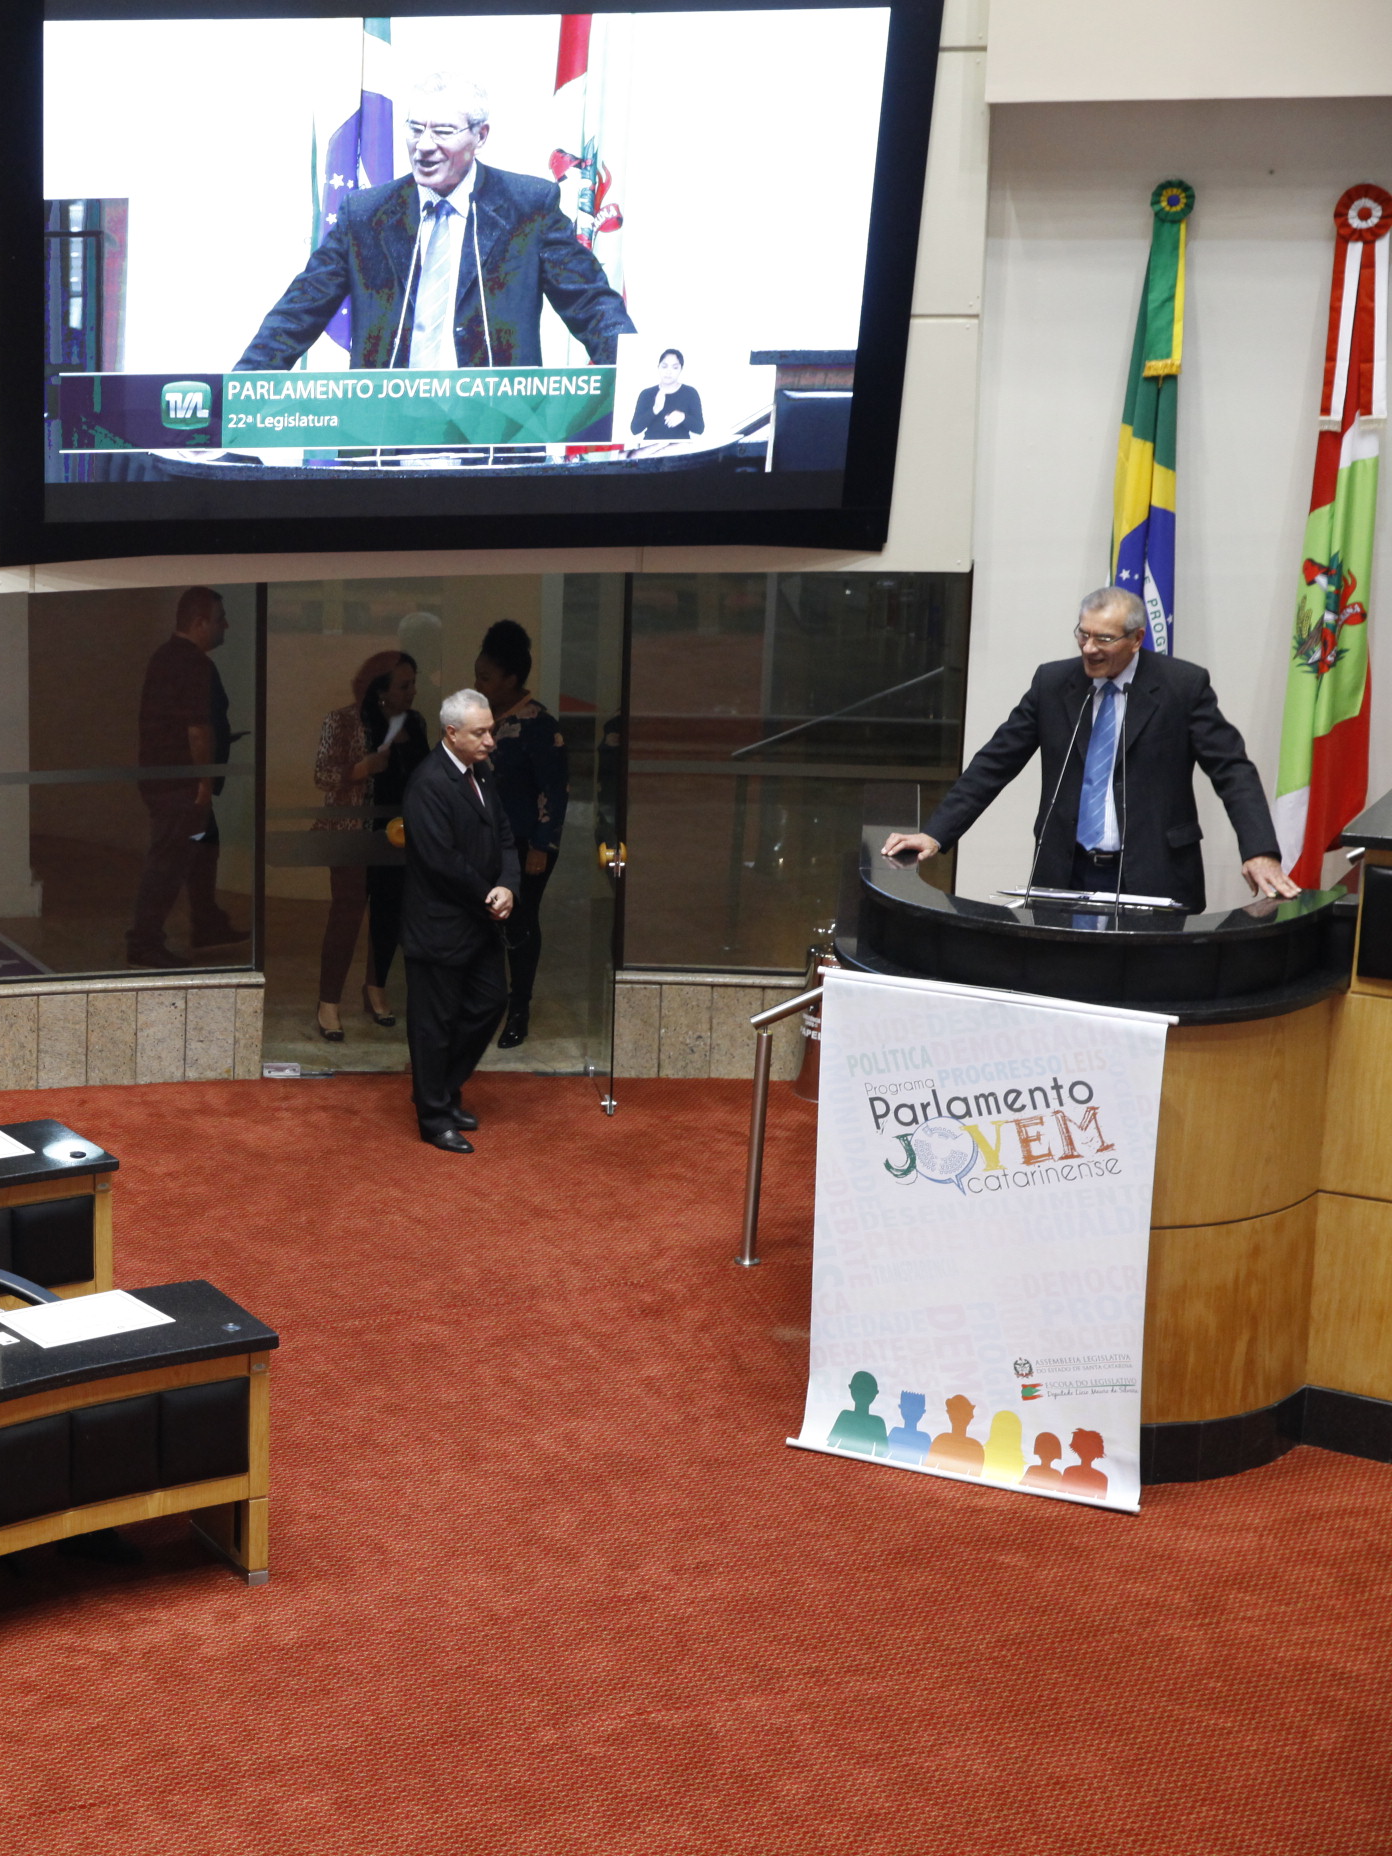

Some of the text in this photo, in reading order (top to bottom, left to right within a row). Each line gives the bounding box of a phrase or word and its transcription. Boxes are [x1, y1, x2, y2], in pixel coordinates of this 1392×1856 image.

[227, 375, 601, 400] PARLAMENTO JOVEM CATARINENSE
[256, 412, 338, 431] Legislatura
[846, 1045, 933, 1077] POLÍTICA
[937, 1048, 1107, 1088] PROGRESSO LEIS
[864, 1078, 935, 1097] Programa
[868, 1076, 1094, 1131] Parlamento
[883, 1106, 1117, 1196] JOVEM
[1035, 1354, 1131, 1366] ASSEMBLEIA LEGISLATIVA
[1045, 1381, 1073, 1389] ESCOLA
[1090, 1378, 1137, 1386] LEGISLATIVO
